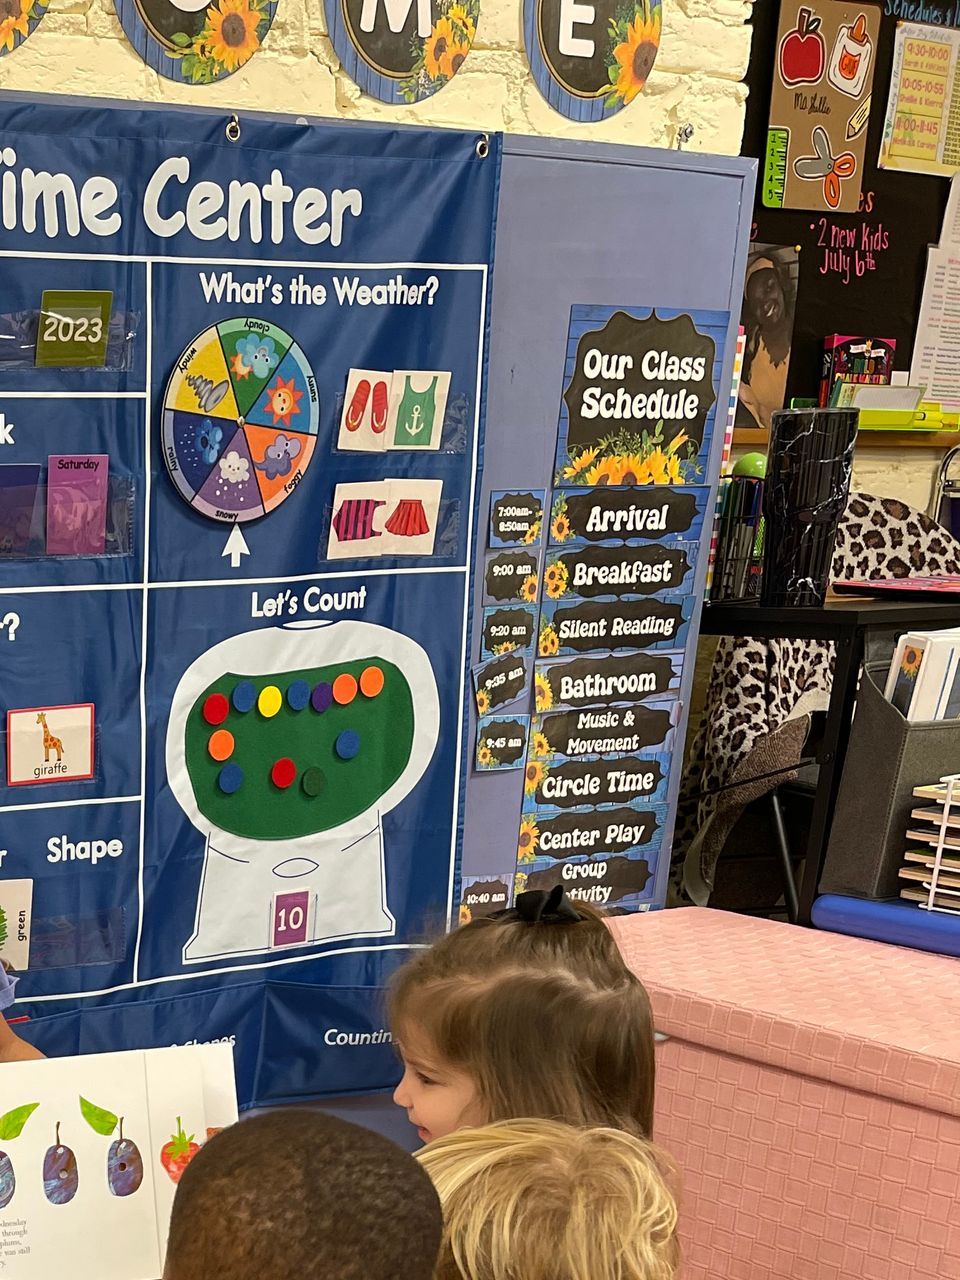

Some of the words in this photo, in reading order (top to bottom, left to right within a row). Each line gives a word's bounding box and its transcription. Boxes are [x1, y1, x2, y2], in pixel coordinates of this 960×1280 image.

[143, 156, 363, 247] Center
[817, 218, 827, 247] 2
[831, 224, 857, 248] new
[820, 249, 851, 284] July
[855, 250, 876, 277] 6th
[199, 271, 283, 305] What's
[290, 274, 327, 305] the
[333, 275, 440, 306] Weather?
[43, 318, 103, 345] 2023
[244, 318, 270, 333] cloudy
[178, 347, 197, 373] windy
[583, 348, 633, 380] Our
[641, 350, 706, 382] Class
[306, 375, 317, 403] sunny
[581, 387, 699, 420] Schedule
[58, 458, 100, 473] Saturday
[167, 446, 179, 472] rainy
[283, 469, 302, 494] foggy
[215, 510, 238, 522] snowy
[499, 521, 529, 532] 8:50am
[586, 504, 669, 532] Arrival
[492, 564, 513, 576] 9:00
[516, 564, 532, 575] am
[573, 560, 673, 586] Breakfast
[251, 590, 298, 617] Let's
[304, 586, 366, 612] Count
[490, 625, 510, 637] 9:20
[512, 626, 526, 635] am
[559, 618, 607, 638] Silent
[611, 616, 675, 637] Reading
[485, 675, 506, 691] 9:35
[507, 667, 523, 679] am
[560, 672, 656, 700] Bathroom
[577, 712, 619, 730] Music
[623, 710, 635, 726] &
[486, 737, 506, 748] 9:45
[507, 737, 522, 747] am
[567, 735, 639, 755] Movement
[33, 762, 68, 779] giraffe
[542, 774, 600, 798] Circle
[607, 770, 654, 793] Time
[540, 828, 600, 850] Center
[606, 823, 645, 845] Play
[47, 835, 123, 864] Shape
[562, 862, 607, 880] Group
[466, 894, 488, 904] 10:40
[491, 892, 505, 902] am
[566, 885, 612, 903] tivity
[18, 910, 27, 941] green
[276, 906, 303, 931] 10
[324, 1028, 397, 1046] Countin
